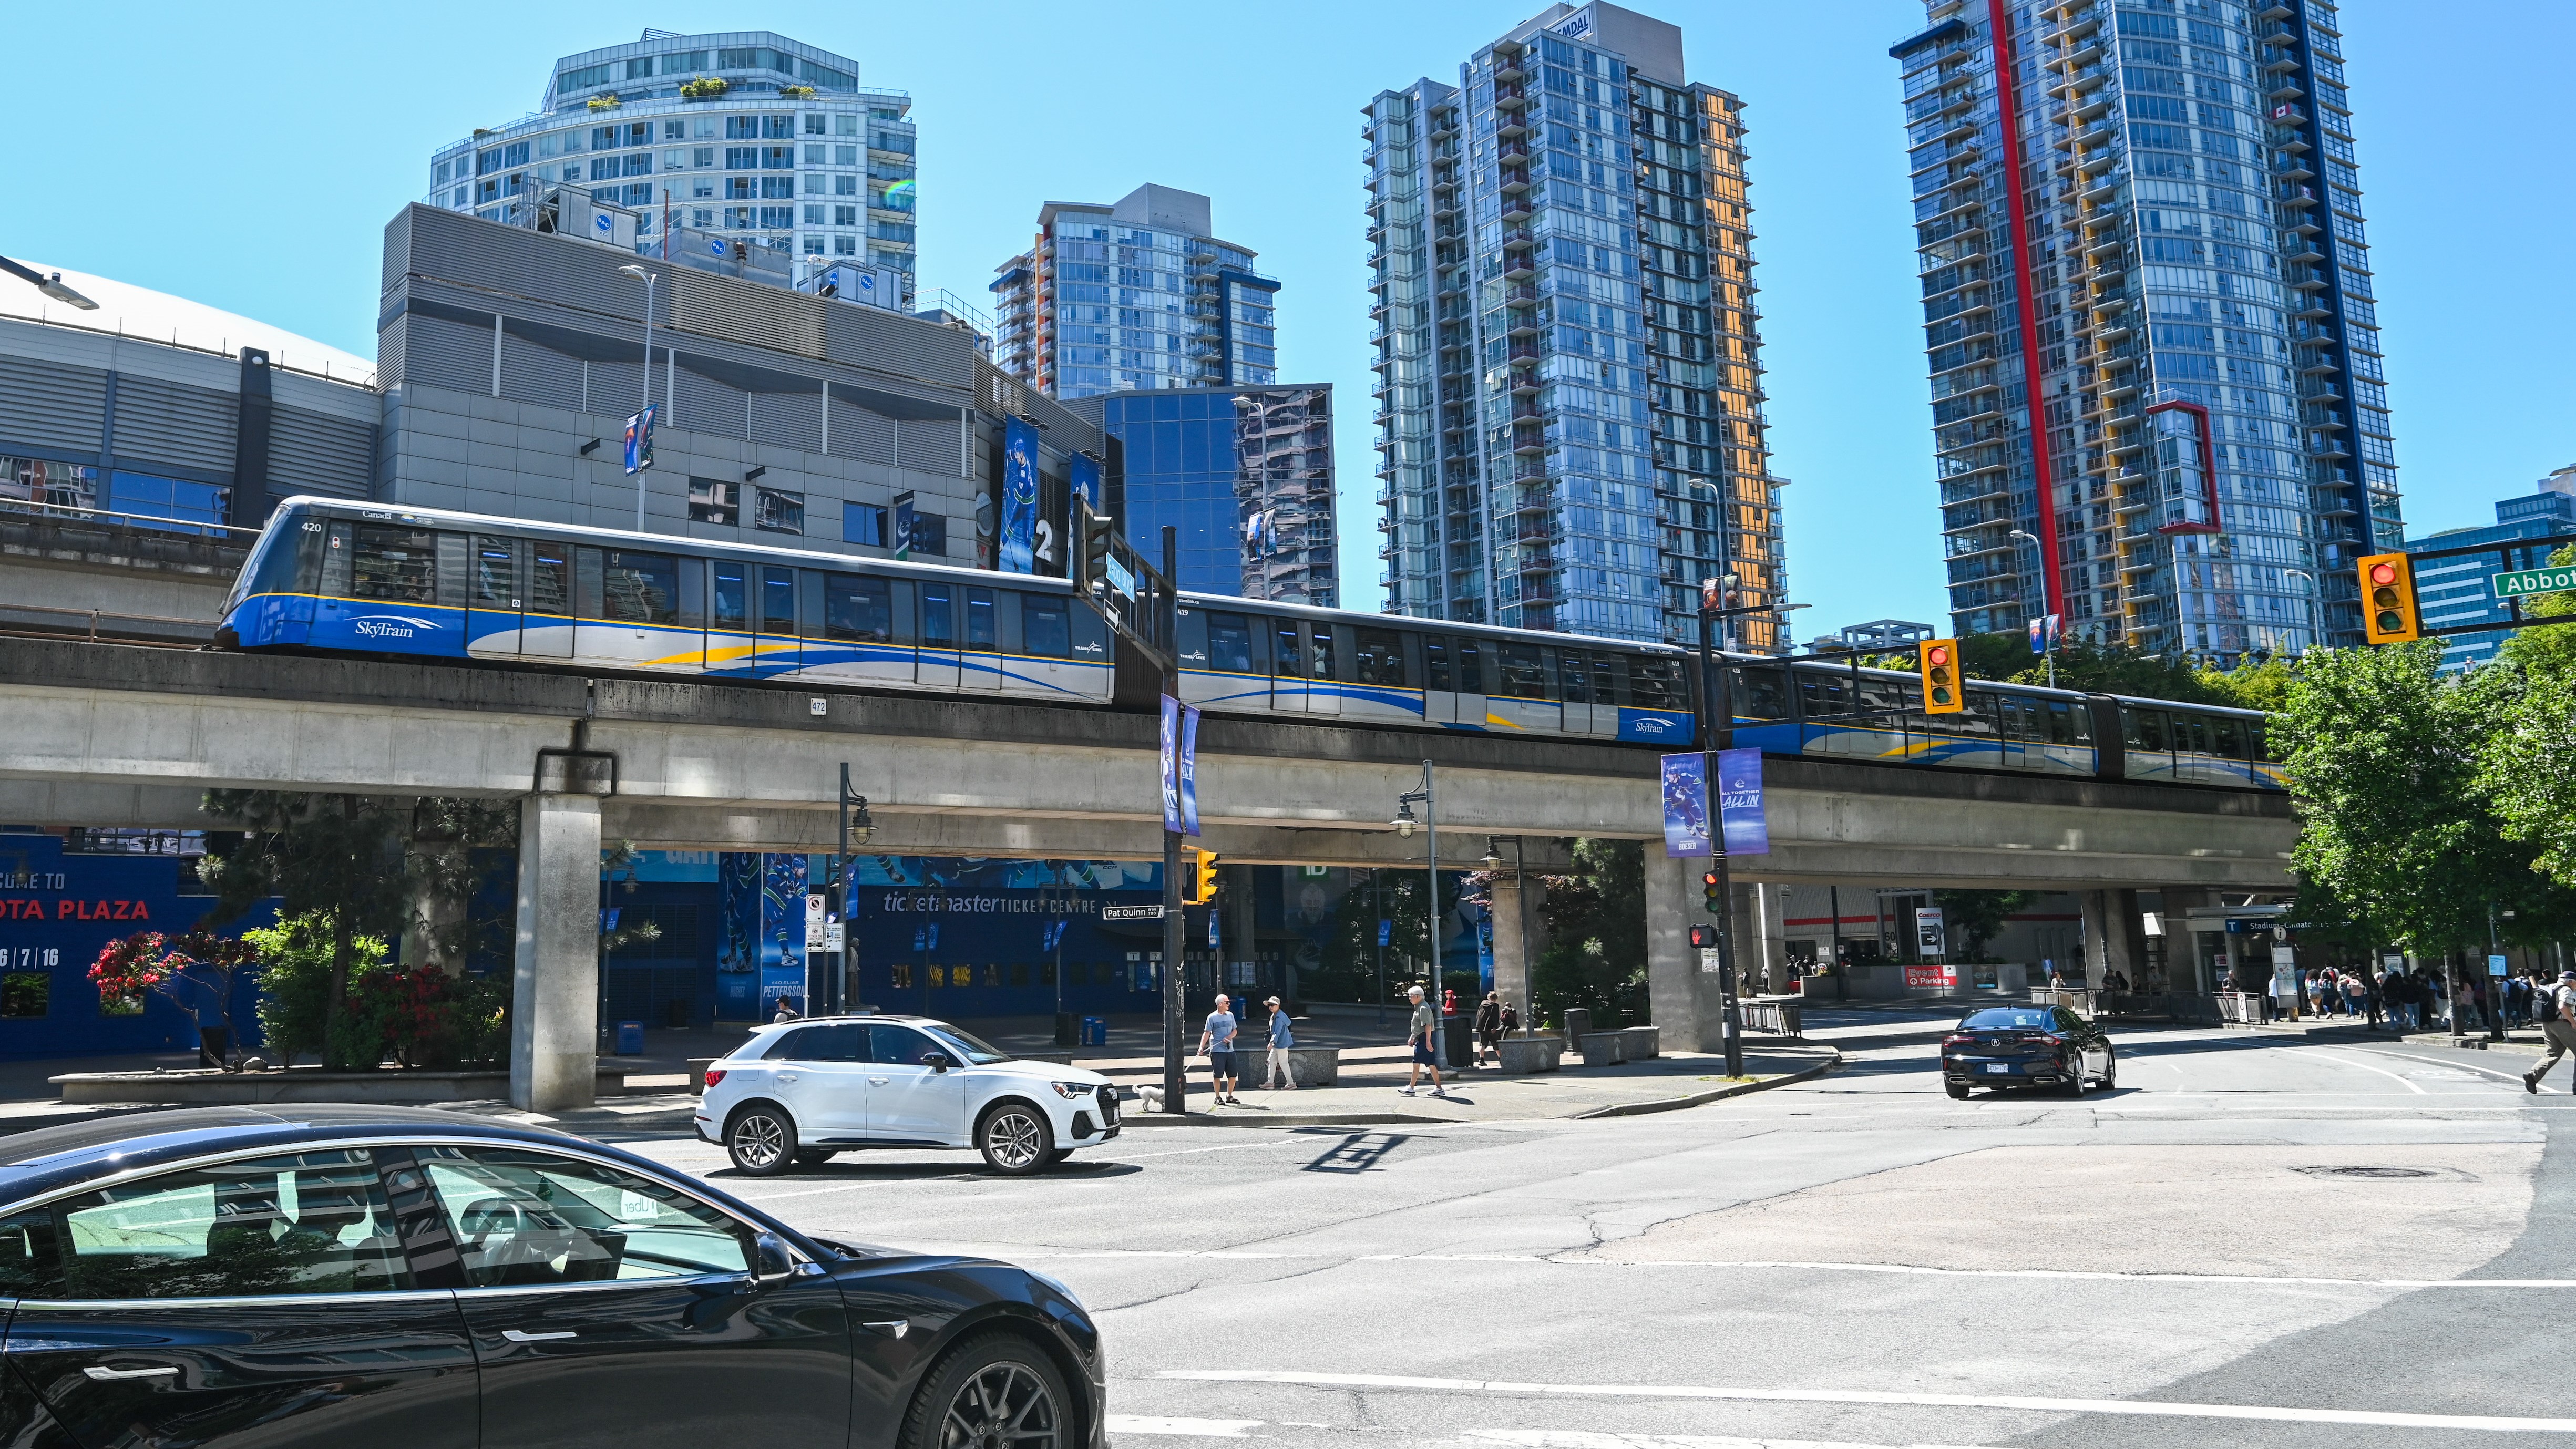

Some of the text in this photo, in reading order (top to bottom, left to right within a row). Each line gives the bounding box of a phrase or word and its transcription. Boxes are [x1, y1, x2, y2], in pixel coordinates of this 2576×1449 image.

[598, 217, 610, 228] BAC
[712, 243, 724, 252] BAC
[861, 278, 872, 287] BAC
[362, 510, 392, 519] Canada
[302, 522, 321, 532] 420
[1035, 519, 1052, 562] 2
[1109, 558, 1133, 594] Expo Blvd
[355, 621, 413, 638] SkyTrain
[813, 702, 825, 711] 472
[1636, 722, 1662, 734] SkyTrain
[1723, 794, 1759, 807] ALL IN
[45, 873, 65, 889] TO
[58, 900, 149, 920] PLAZA
[1001, 899, 1042, 913] TICKE
[1123, 908, 1146, 917] Quinn
[2228, 922, 2236, 931] T
[22, 949, 30, 967] 7
[43, 948, 59, 967] 16
[763, 985, 805, 998] PETTERSSON
